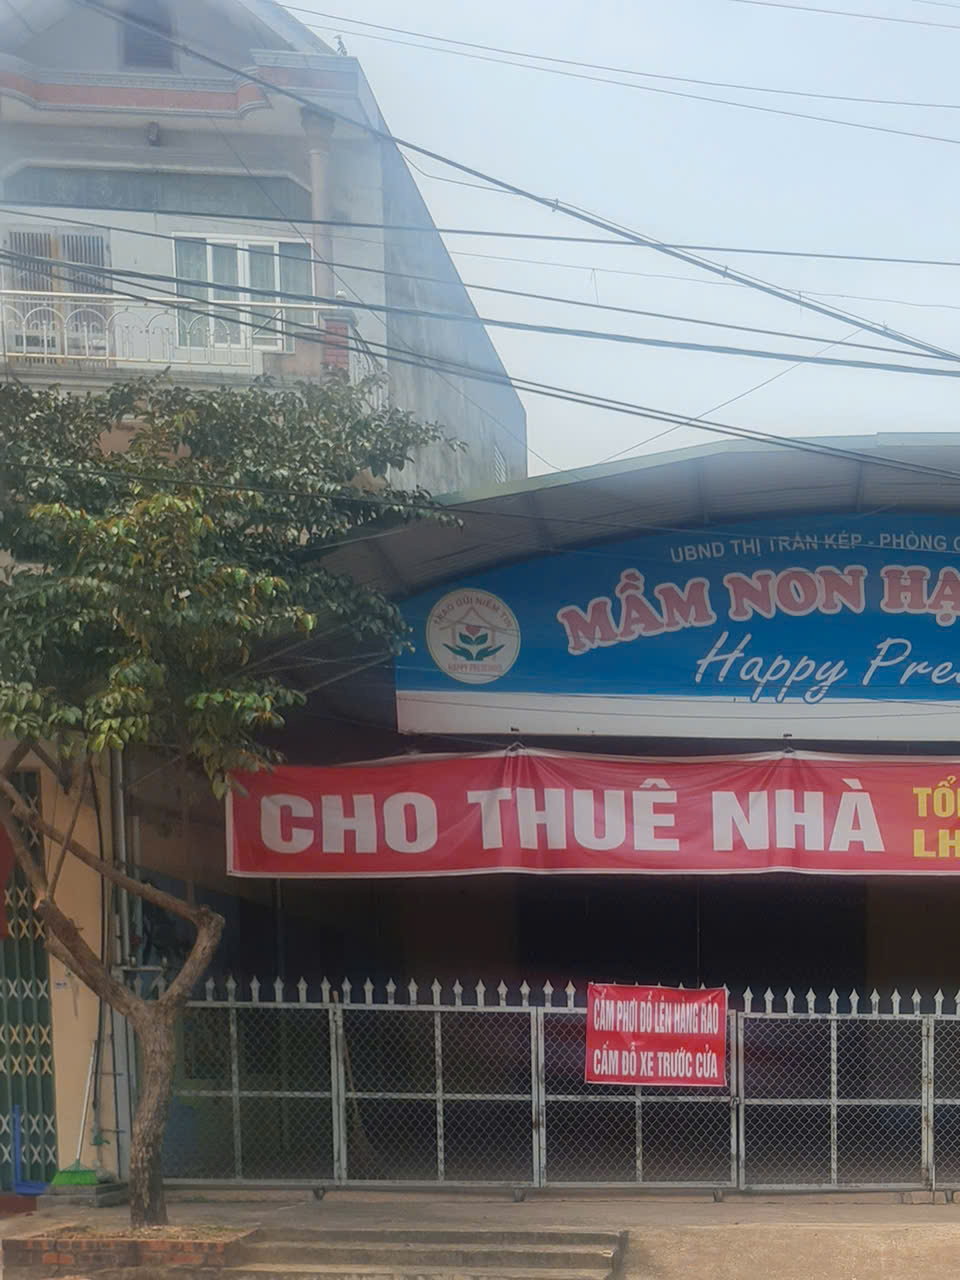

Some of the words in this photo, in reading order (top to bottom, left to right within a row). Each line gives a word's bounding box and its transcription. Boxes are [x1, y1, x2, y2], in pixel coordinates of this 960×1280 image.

[670, 541, 725, 563] UBND
[729, 538, 762, 557] THỊ
[879, 530, 947, 551] PHÒNG
[557, 568, 717, 655] MẦM
[723, 564, 868, 621] NON
[695, 630, 848, 705] Happy
[260, 791, 438, 854] CHO
[467, 778, 680, 851] THUÊ
[711, 778, 886, 852] NHÀ
[654, 996, 672, 1034] LÊN
[593, 1040, 619, 1076] CẤM
[639, 1052, 655, 1077] XE
[656, 1046, 693, 1078] TRƯỚC
[695, 1043, 718, 1079] CỬA
